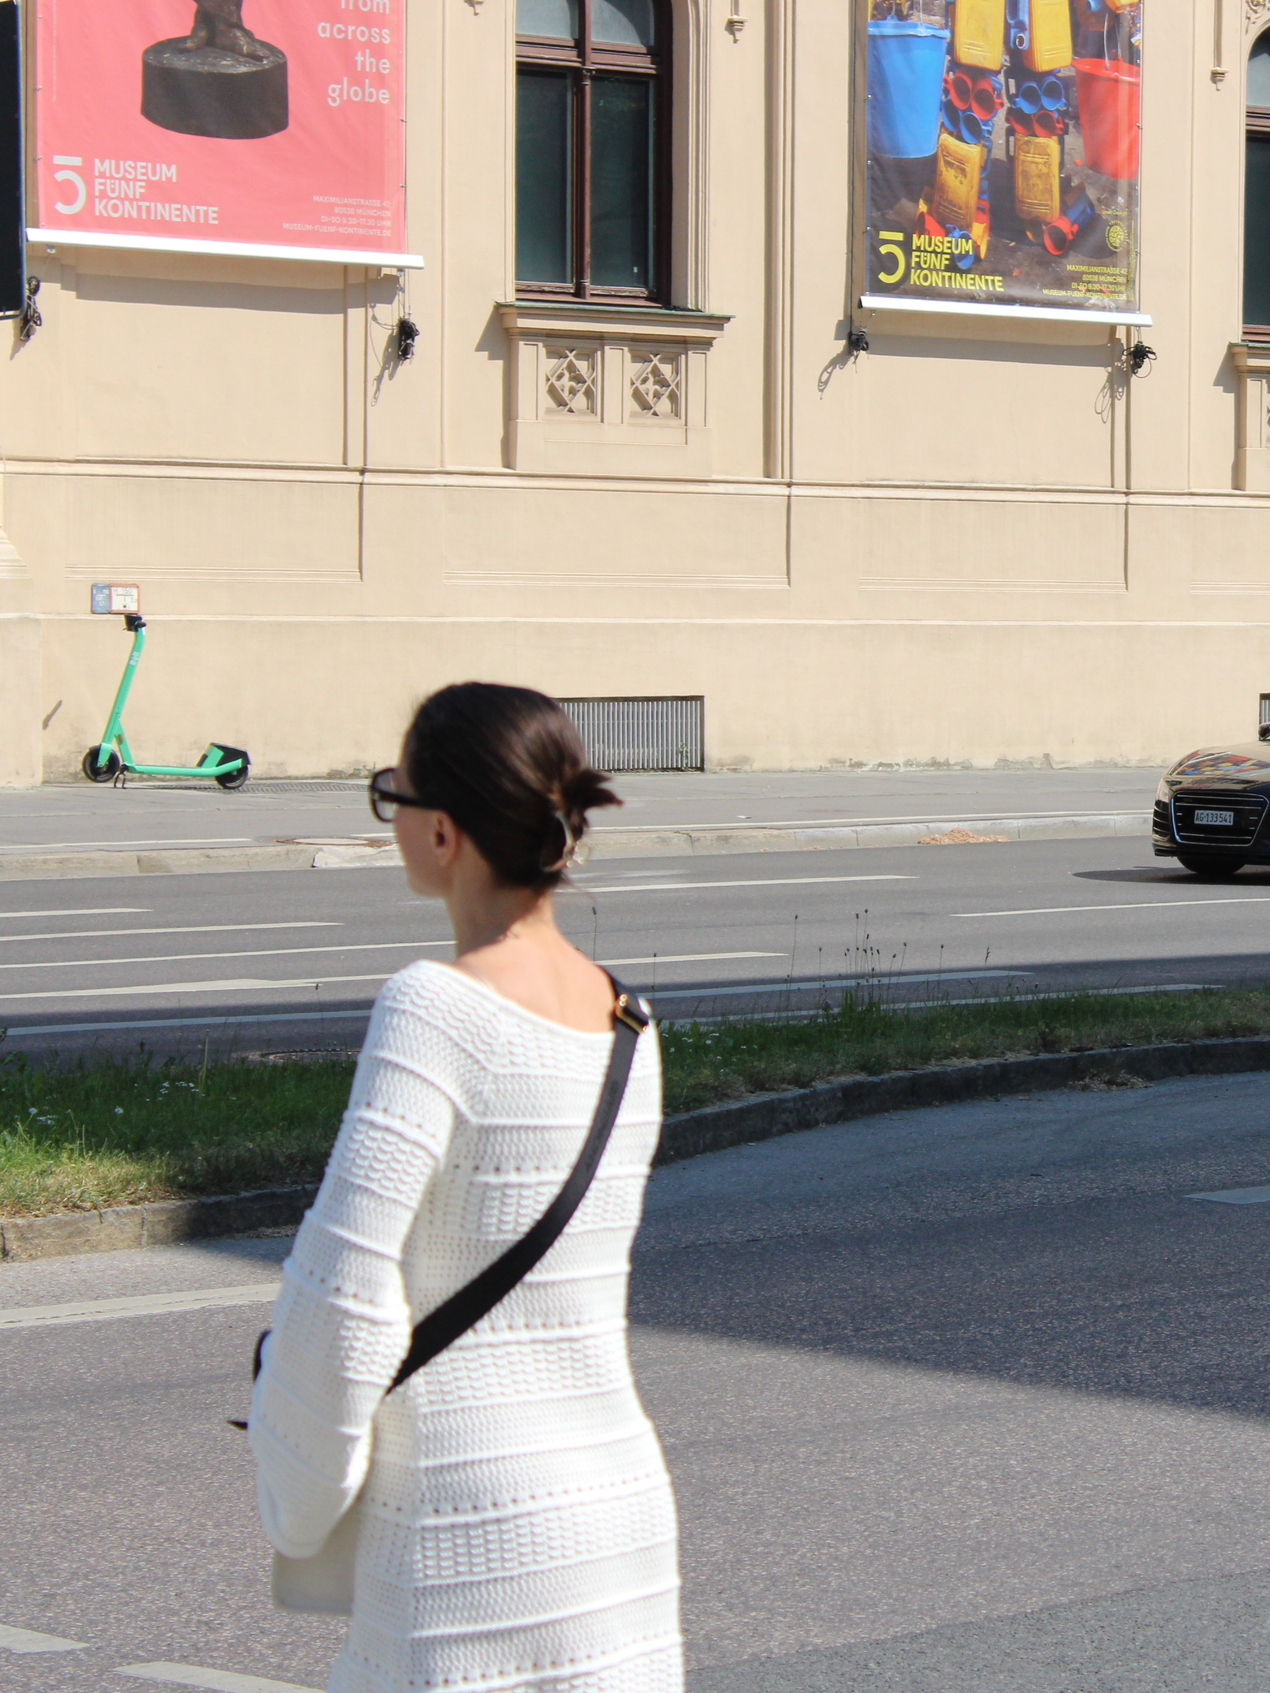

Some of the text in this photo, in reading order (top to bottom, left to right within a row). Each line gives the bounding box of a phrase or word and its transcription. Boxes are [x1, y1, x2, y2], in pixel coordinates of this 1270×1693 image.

[317, 22, 391, 44] across
[355, 49, 390, 74] the
[327, 77, 390, 107] globe
[93, 158, 177, 182] MUSEUM
[94, 178, 146, 199] FÜNF
[94, 198, 219, 225] KONTINENTE
[312, 195, 391, 208] MAXIMILIANSTRASSE 42
[356, 207, 391, 217] MÜNCHEN
[912, 233, 973, 255] MUSEUM
[911, 251, 951, 270] FÜNF
[910, 268, 1005, 292] KONTINENTE
